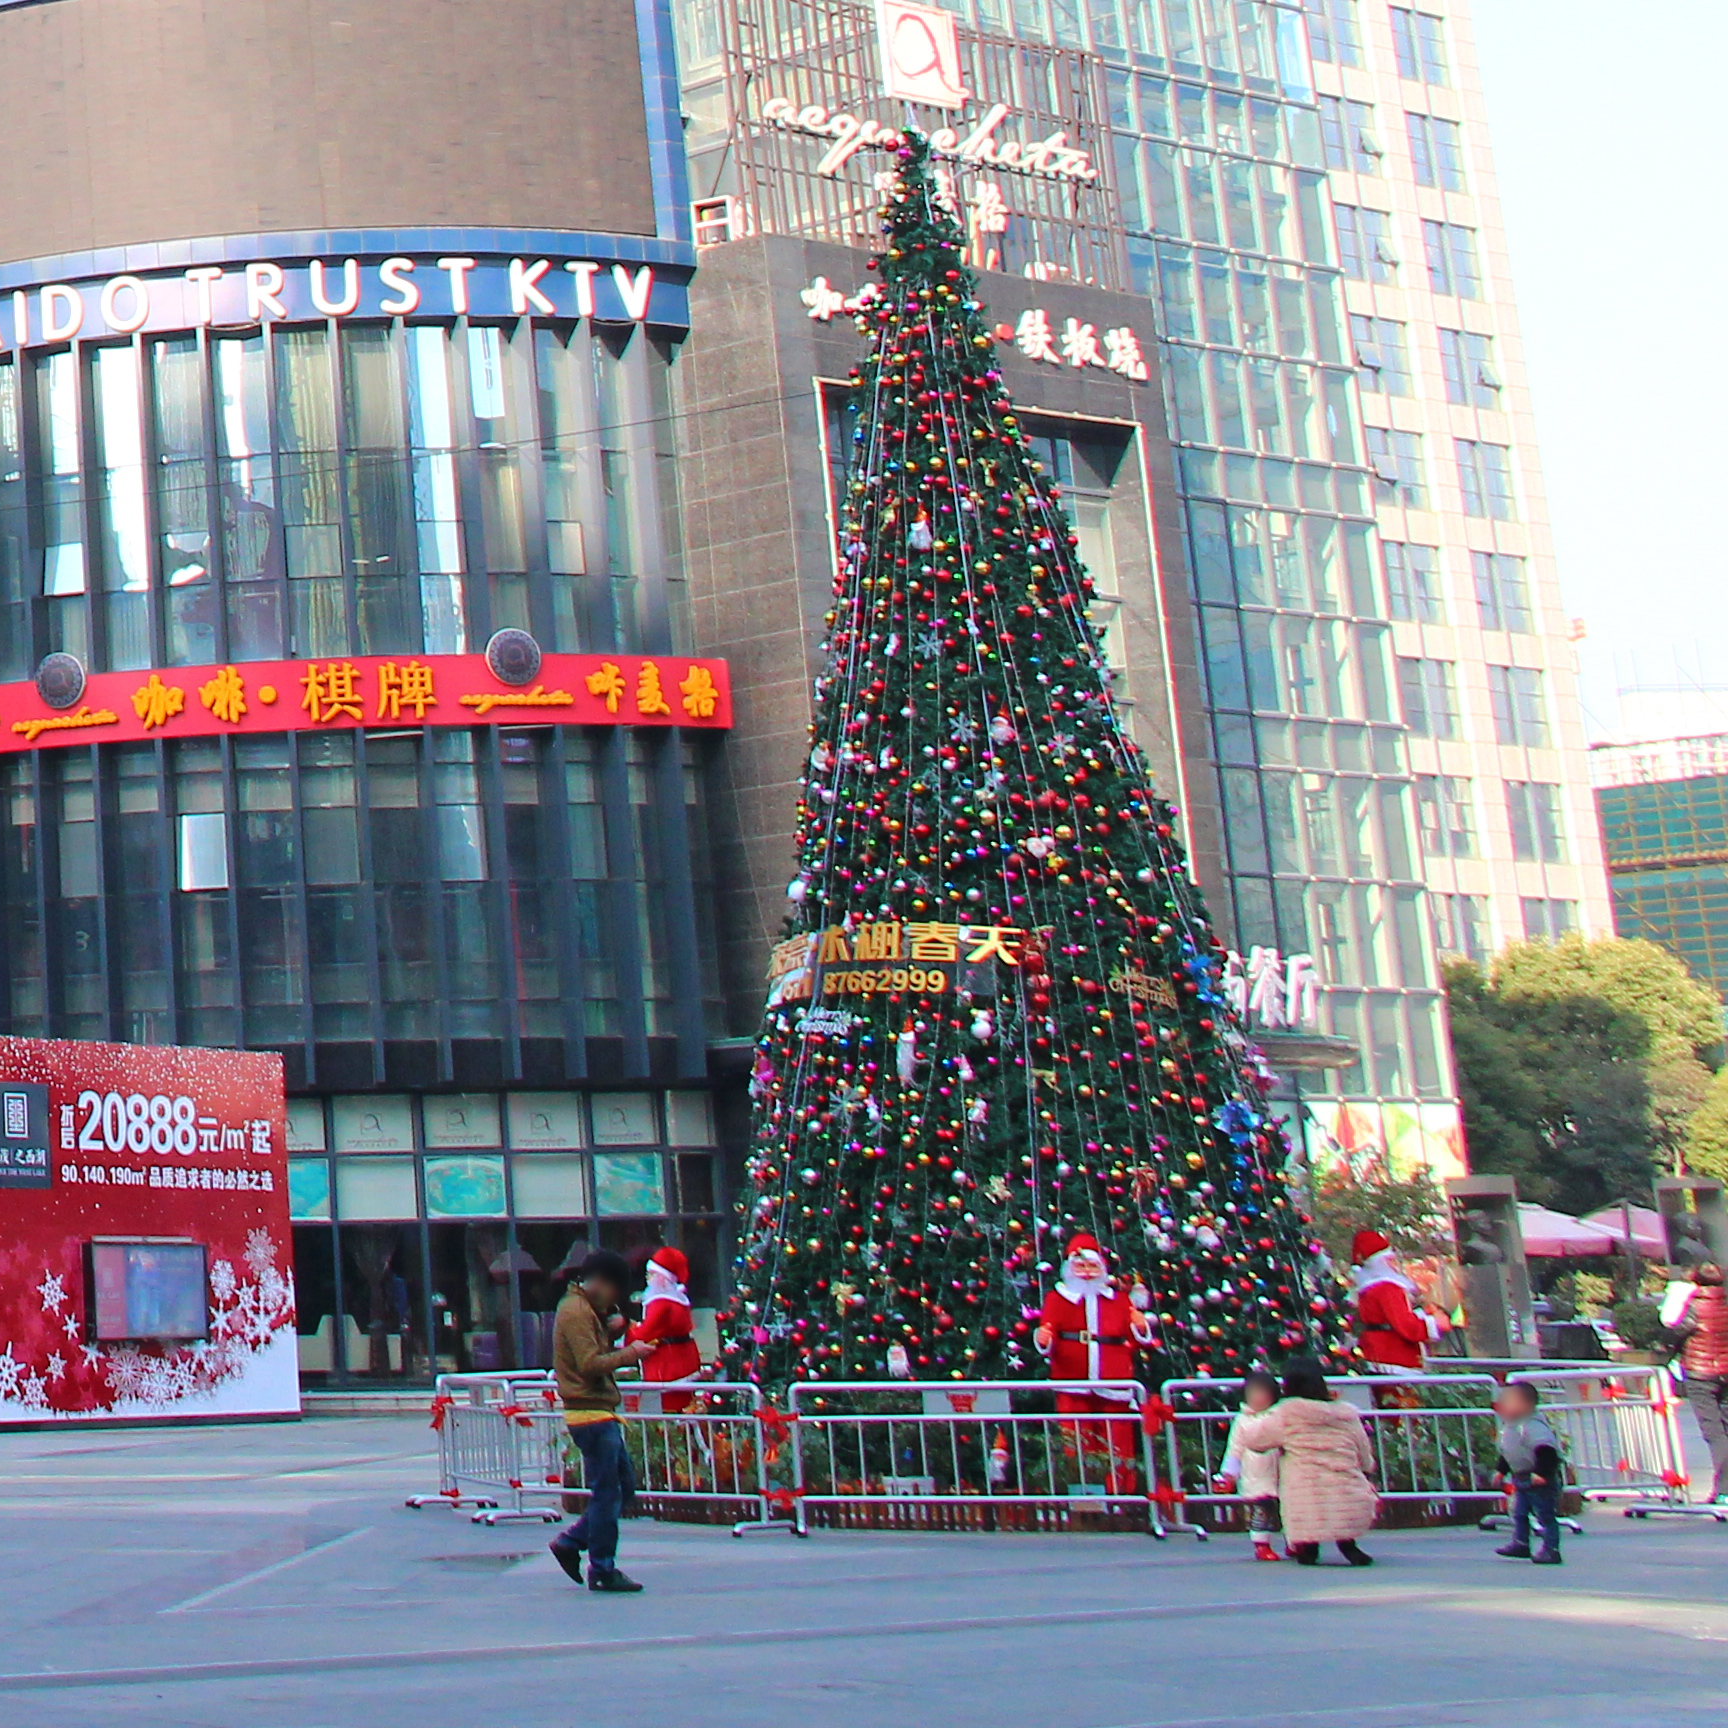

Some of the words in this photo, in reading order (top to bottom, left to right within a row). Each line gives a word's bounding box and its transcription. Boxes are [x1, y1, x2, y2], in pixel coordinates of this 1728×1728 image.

[186, 256, 478, 324] TRUST
[510, 258, 654, 321] KTV
[822, 969, 947, 995] 87662999
